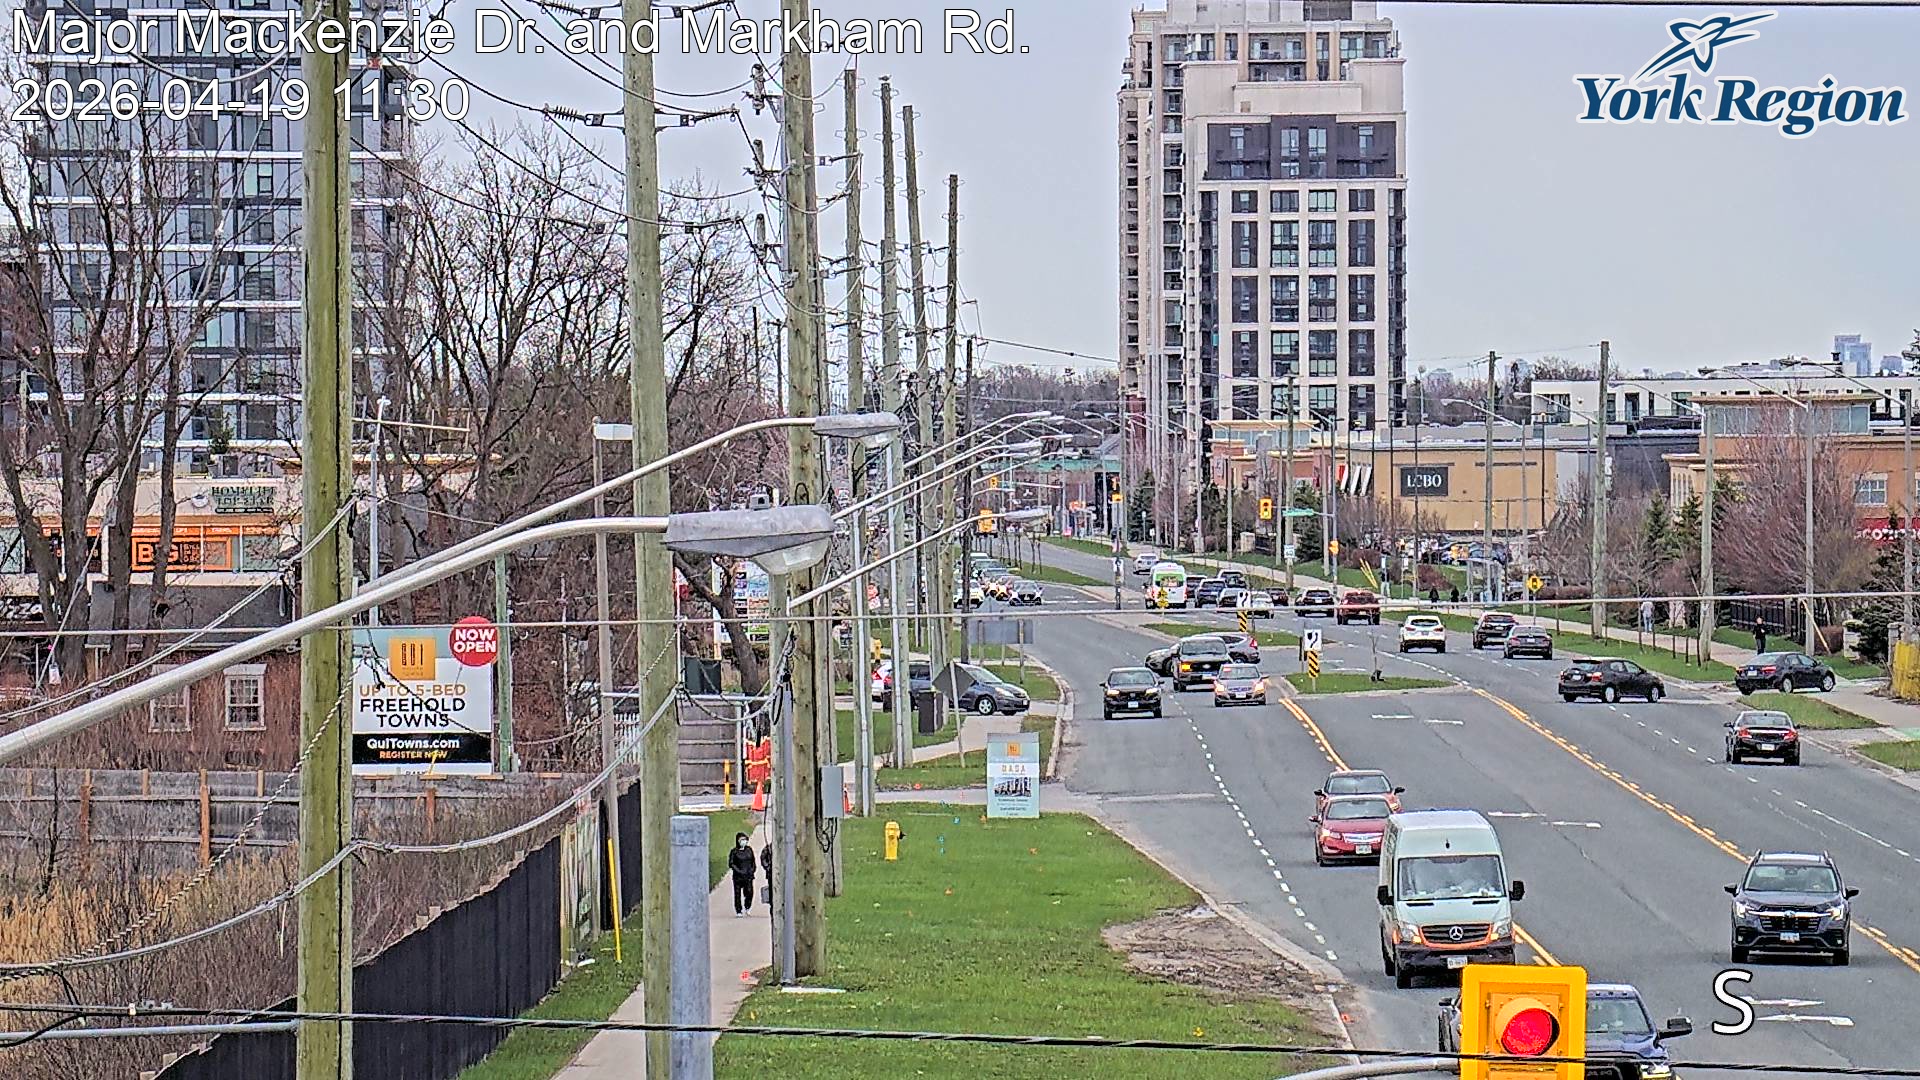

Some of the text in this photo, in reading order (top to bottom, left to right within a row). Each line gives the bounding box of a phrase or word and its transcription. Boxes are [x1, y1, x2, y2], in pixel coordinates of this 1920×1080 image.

[1407, 473, 1442, 488] LCBO
[138, 542, 180, 563] BG
[455, 628, 496, 641] NOW
[453, 640, 497, 653] OPEN
[359, 684, 467, 697] UP TO 5-BED
[359, 698, 466, 713] FREEHOLD
[376, 713, 451, 728] TOWNS
[379, 750, 424, 759] REGISTER
